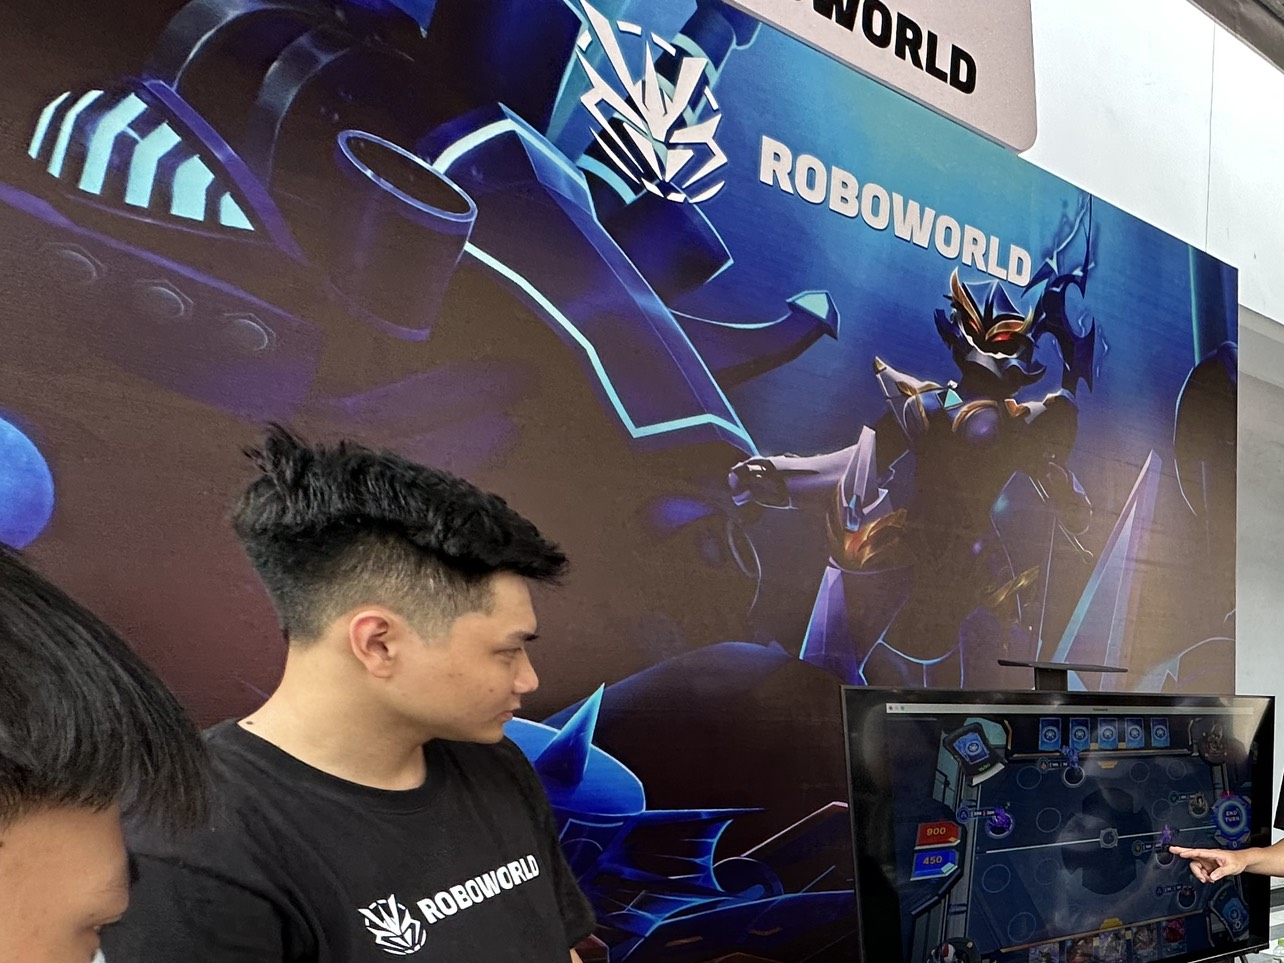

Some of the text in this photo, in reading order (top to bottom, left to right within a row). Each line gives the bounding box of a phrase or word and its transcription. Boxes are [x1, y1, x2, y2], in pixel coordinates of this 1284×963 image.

[759, 134, 1032, 287] ROBOWORLD
[926, 826, 947, 837] 900
[922, 855, 943, 866] 450
[417, 854, 541, 925] ROBOWORLD
